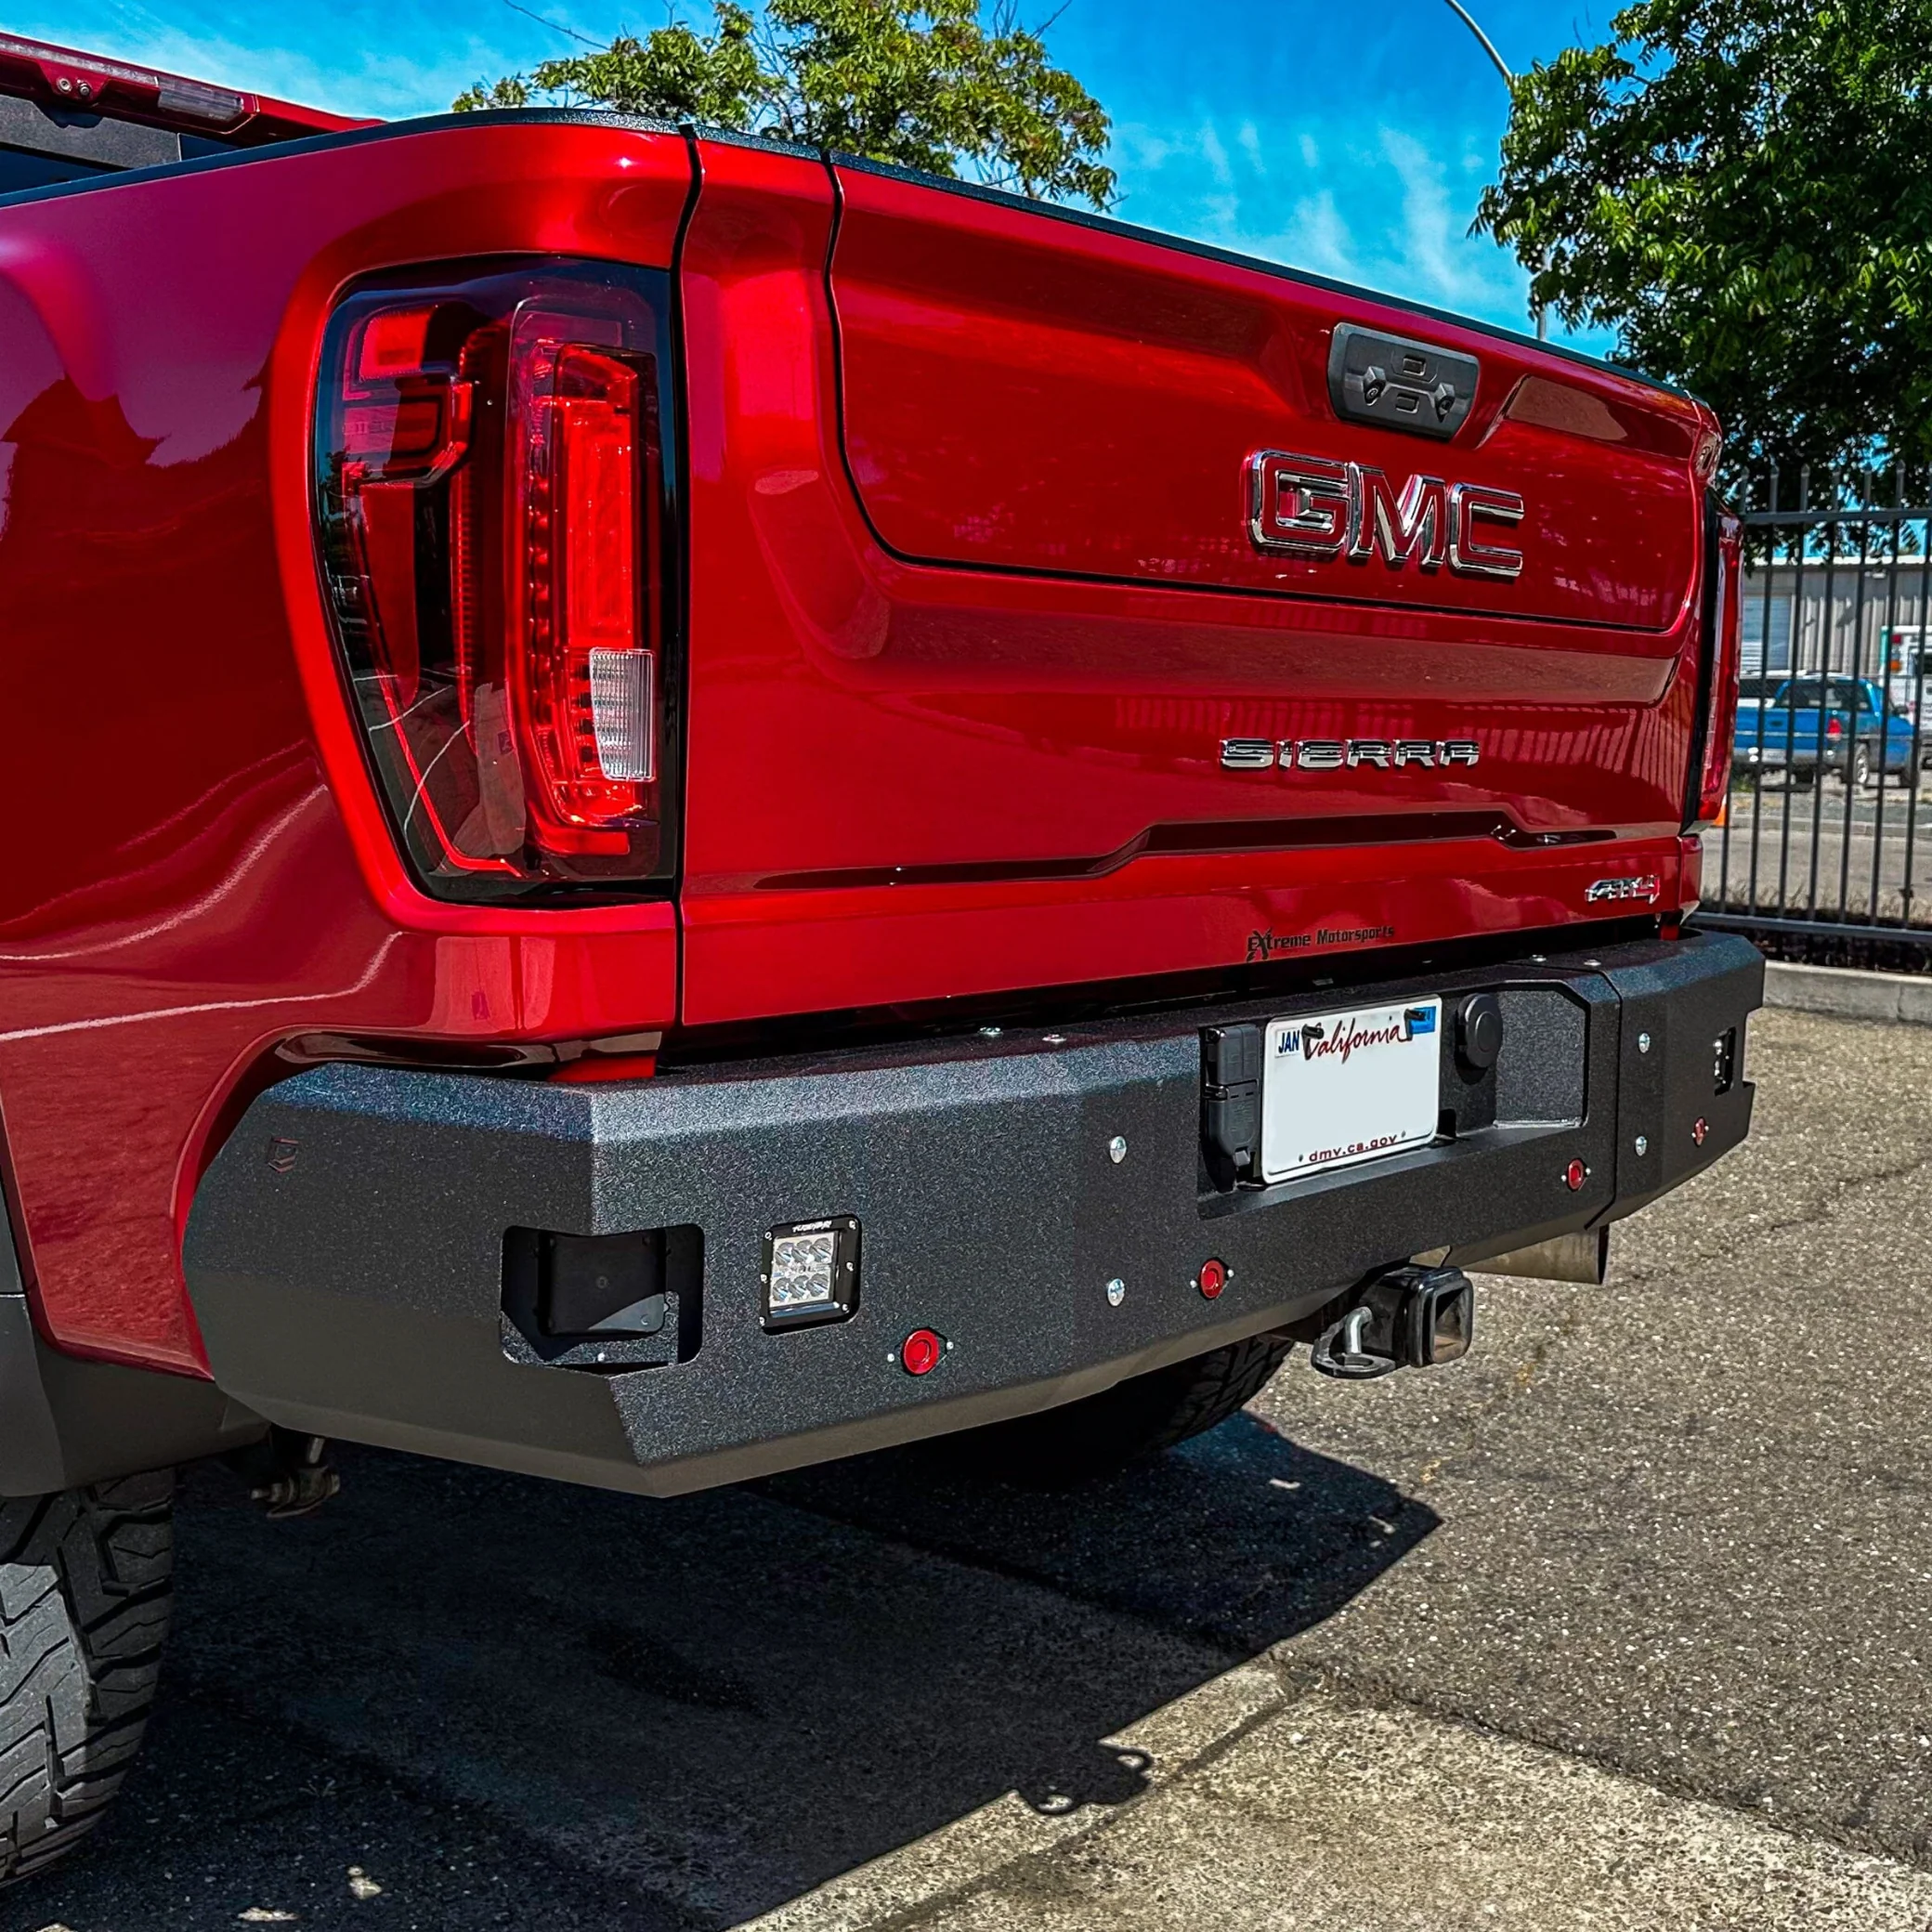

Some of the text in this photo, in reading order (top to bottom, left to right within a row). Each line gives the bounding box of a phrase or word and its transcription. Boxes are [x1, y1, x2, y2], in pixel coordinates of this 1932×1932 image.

[1249, 448, 1524, 577] GMC
[1220, 738, 1480, 768] SIERRA
[1316, 926, 1395, 945] Motorsports
[1278, 1029, 1299, 1053] JAN
[1309, 1134, 1397, 1162] dmv.ca.gov
